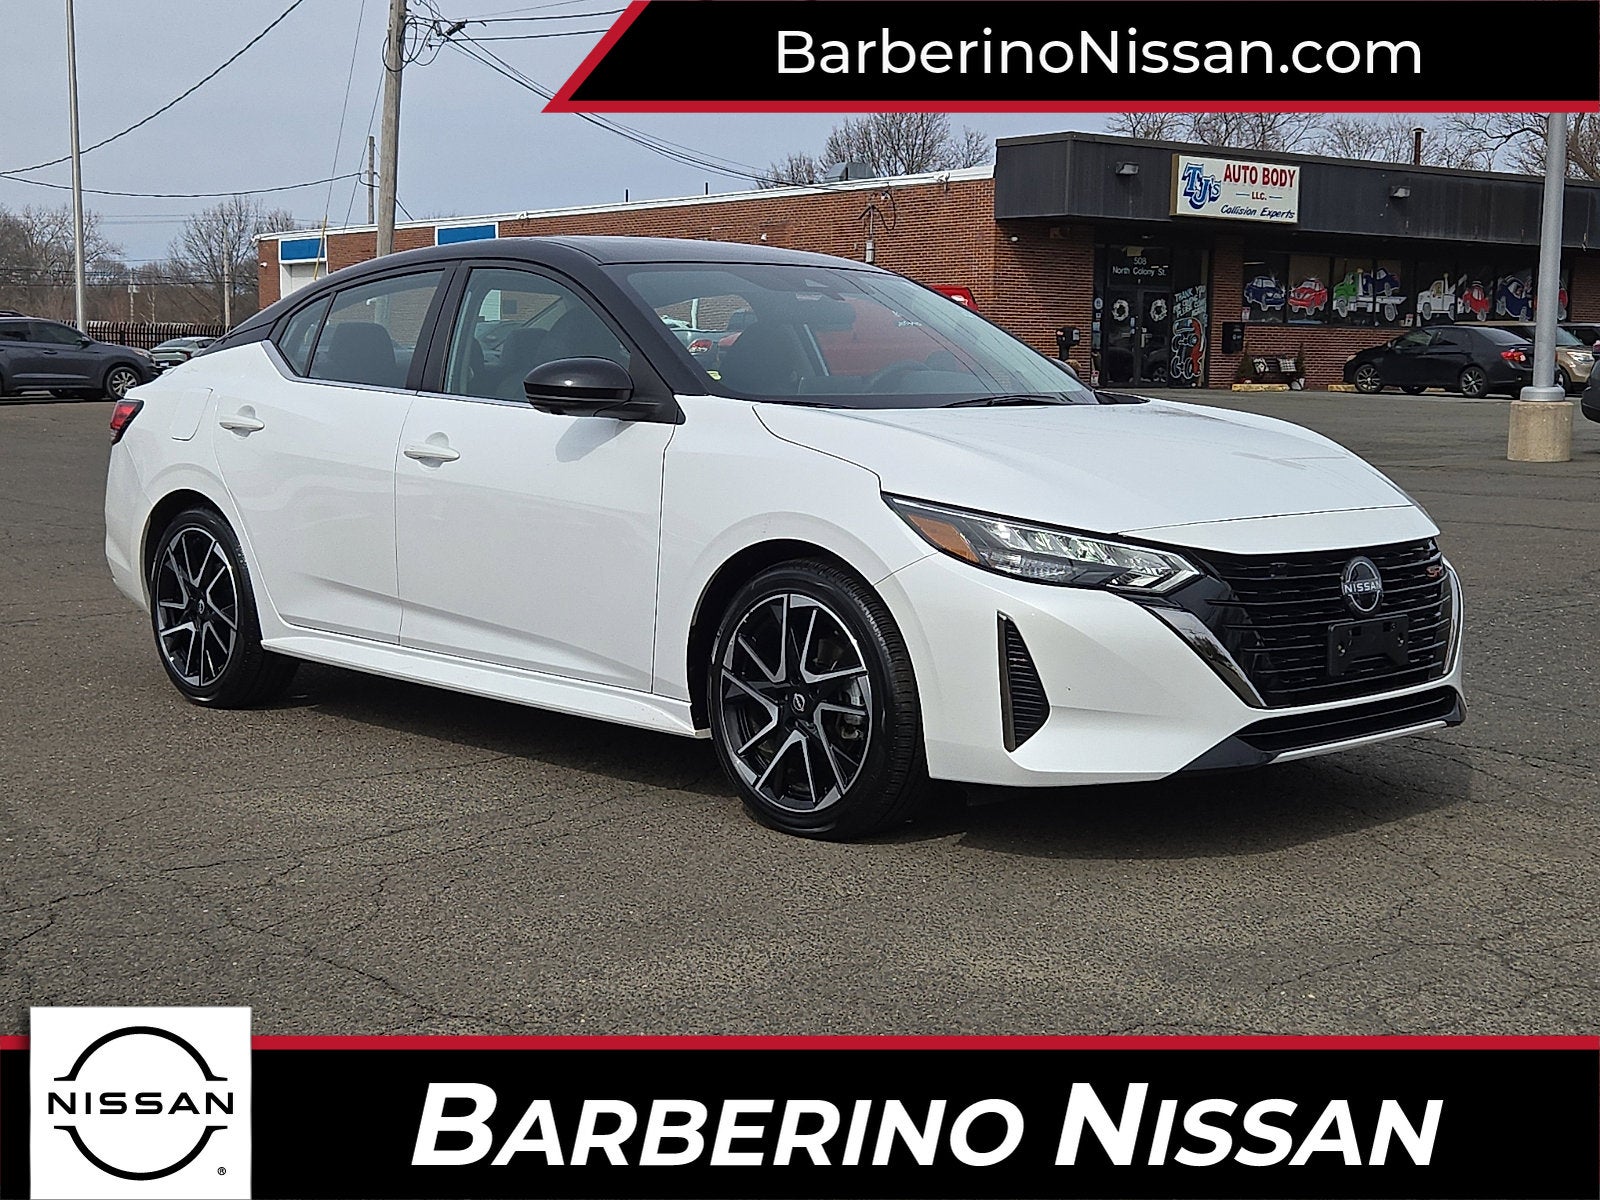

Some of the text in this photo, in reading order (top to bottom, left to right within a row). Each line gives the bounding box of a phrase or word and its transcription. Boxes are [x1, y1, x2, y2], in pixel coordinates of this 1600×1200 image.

[1223, 163, 1296, 188] AUTO BODY
[1220, 204, 1295, 219] Collision Experts
[1112, 265, 1131, 275] North
[1343, 581, 1381, 594] NISSAN
